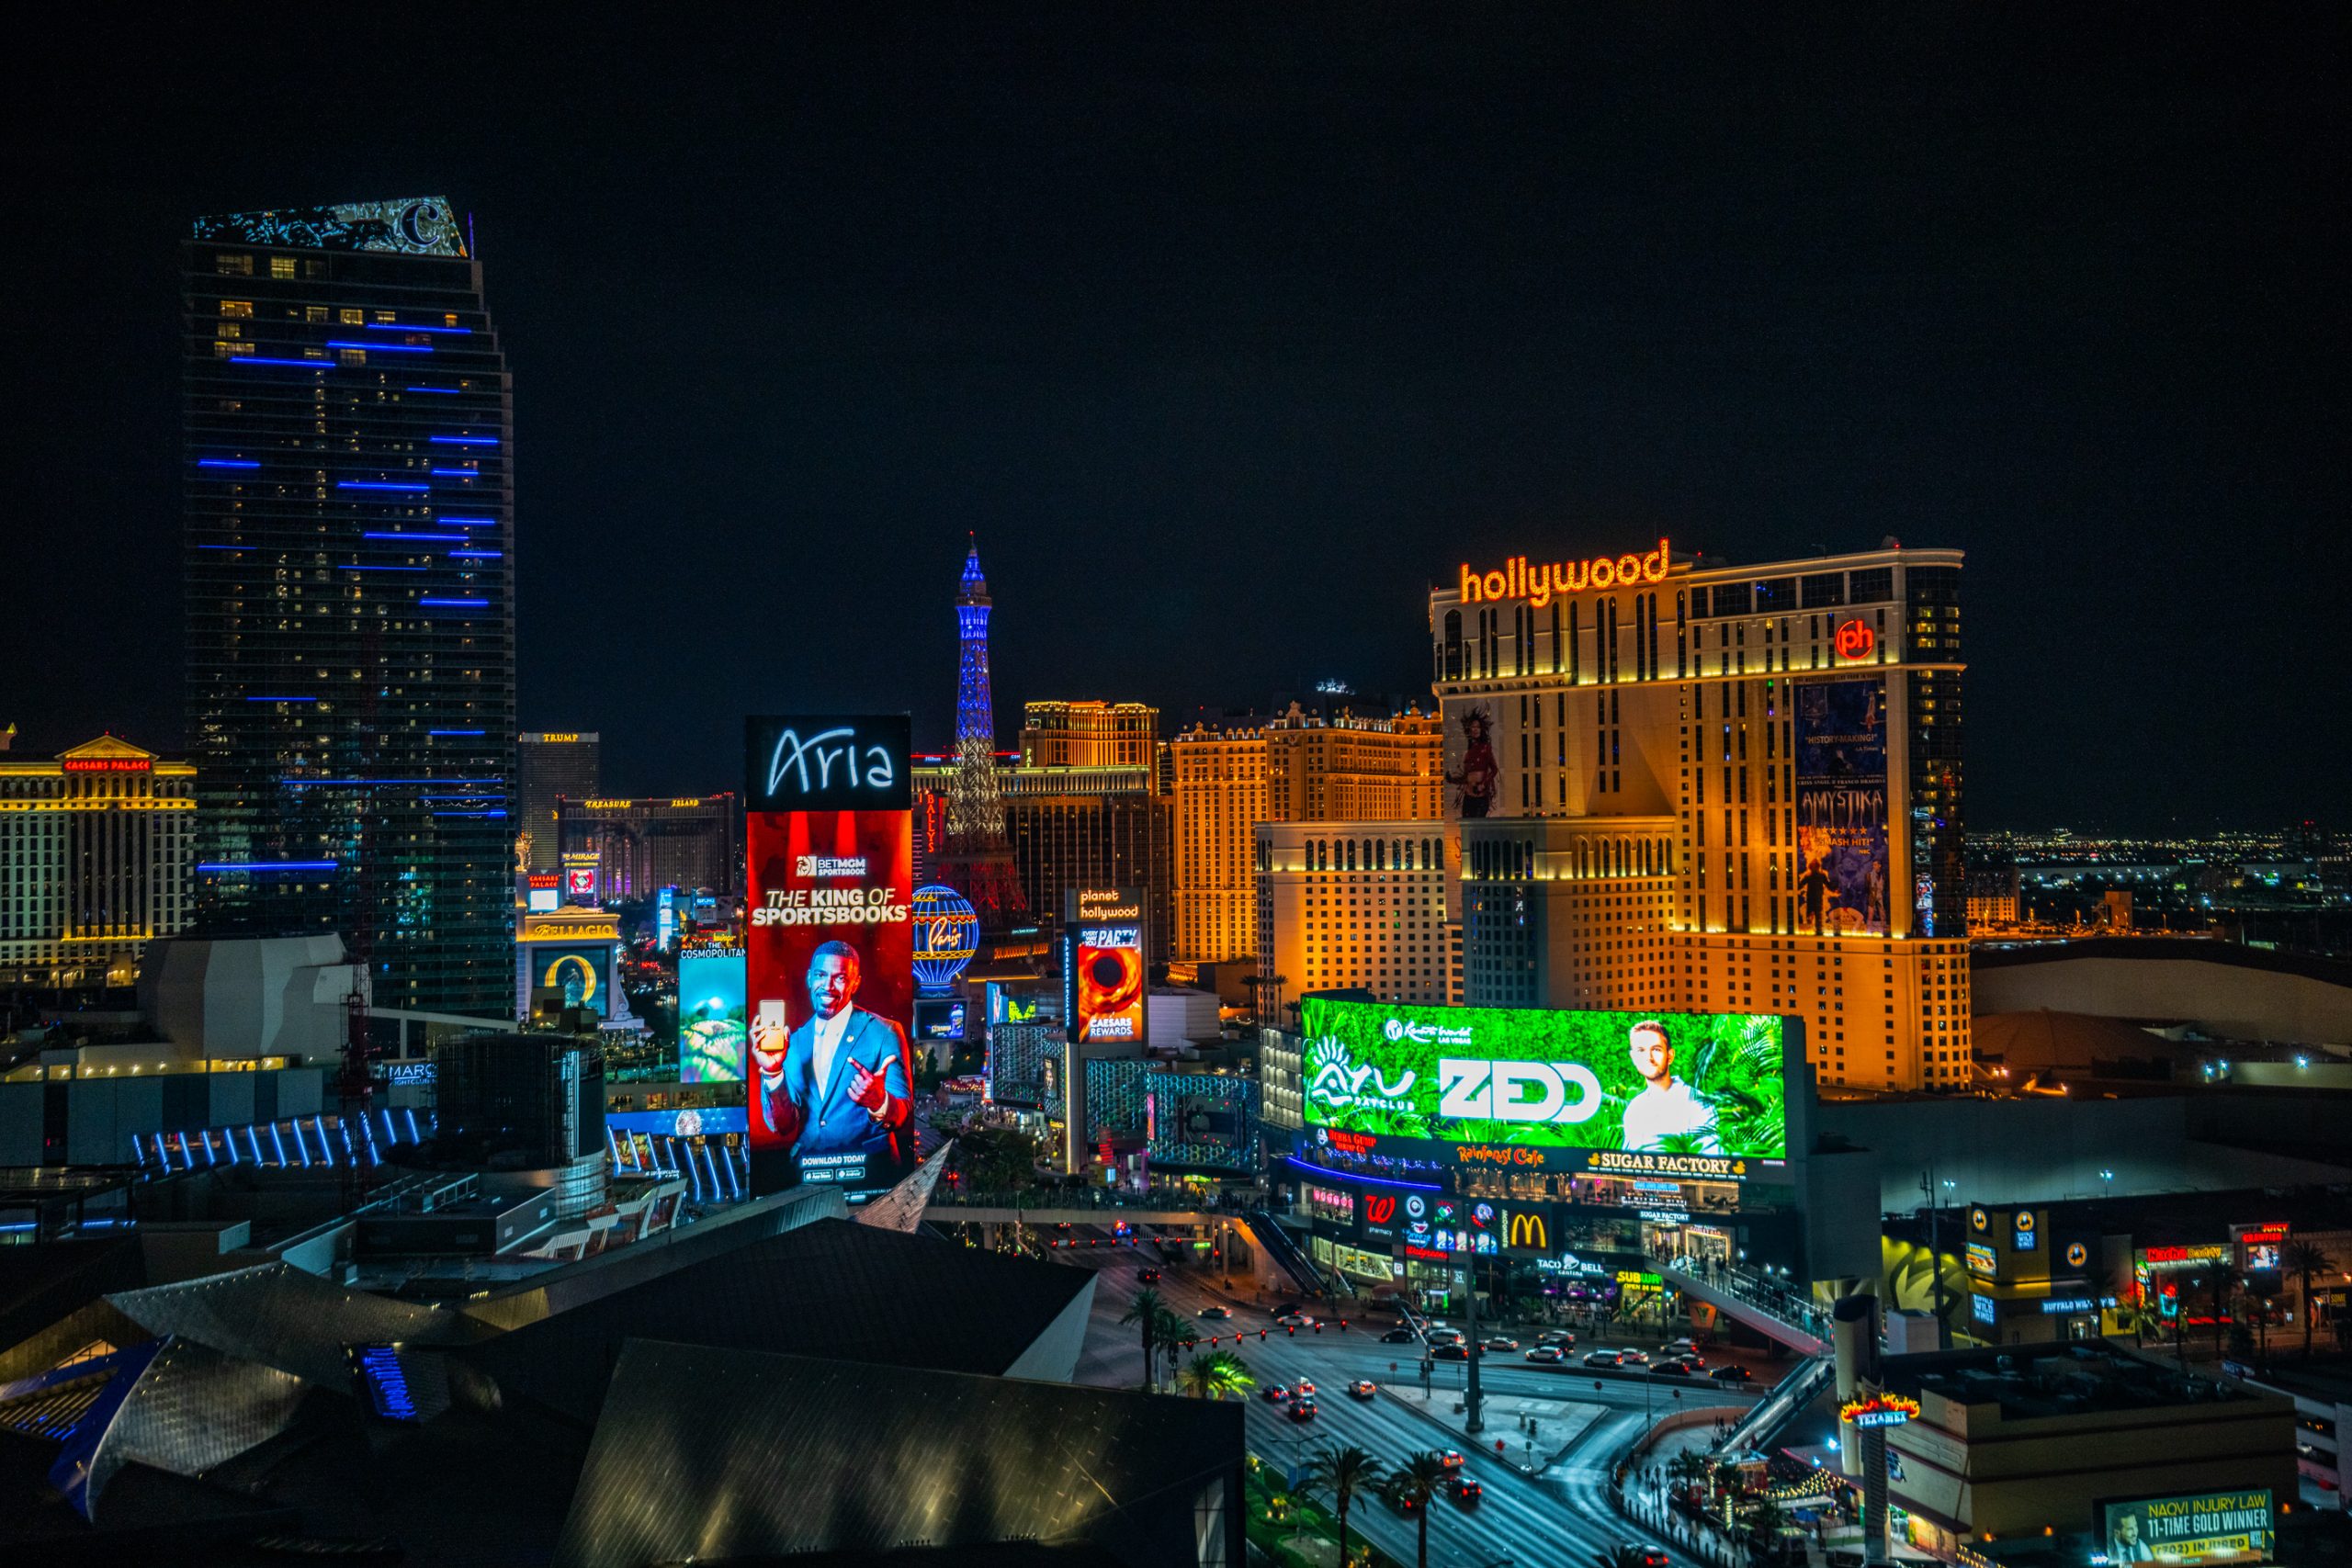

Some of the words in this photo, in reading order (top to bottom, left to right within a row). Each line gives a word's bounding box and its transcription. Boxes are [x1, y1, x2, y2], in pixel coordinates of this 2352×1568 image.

[1459, 536, 1669, 608] hollywood
[1840, 619, 1874, 654] ph
[543, 733, 579, 742] TRUMP
[63, 761, 109, 771] CAESARS
[111, 761, 150, 771] PALACE
[766, 728, 894, 796] Aria
[584, 799, 631, 808] TREASURE
[672, 799, 699, 807] ISLAND
[1802, 790, 1883, 818] AMYSTIKA
[818, 858, 865, 869] BETMGM
[818, 868, 866, 876] SPORTSBOOK
[765, 888, 808, 908] THE
[810, 887, 865, 908] KING
[868, 886, 897, 906] OF
[1080, 889, 1119, 905] planet
[751, 905, 909, 927] SPORTSBOOKS
[1080, 905, 1138, 920] hollywood
[535, 924, 613, 936] BELLAGIO
[928, 917, 963, 956] Paris
[1090, 1017, 1133, 1028] CAESARS
[1090, 1027, 1133, 1037] REWARDS
[1439, 1057, 1602, 1122] ZEDD
[1355, 1096, 1415, 1111] DAYCLUB
[1353, 1134, 1376, 1147] GUMP
[802, 1156, 842, 1166] DOWNLOAD
[843, 1155, 866, 1164] TODAY
[1456, 1145, 1511, 1165] Rainforest
[1513, 1147, 1544, 1168] Cafe
[1601, 1153, 1655, 1169] SUGAR
[1657, 1156, 1732, 1174] FACTORY
[1640, 1211, 1660, 1219] SUGAR
[1661, 1212, 1690, 1221] FACTORY
[2263, 1223, 2289, 1233] JUICY
[1537, 1258, 1561, 1269] TACO
[1581, 1262, 1604, 1273] BELL
[1973, 1301, 1994, 1314] WILD
[2042, 1301, 2074, 1314] BUFFALO
[1858, 1413, 1877, 1426] TEX
[1884, 1410, 1907, 1424] MEX
[2148, 1500, 2188, 1517] NAQVI
[2193, 1497, 2236, 1514] INJURY
[2239, 1495, 2267, 1509] LAW
[2148, 1516, 2190, 1539] 11-TIME
[2193, 1512, 2220, 1535] GOLD
[2222, 1508, 2268, 1532] WINNER
[2193, 1538, 2245, 1552] INJURED
